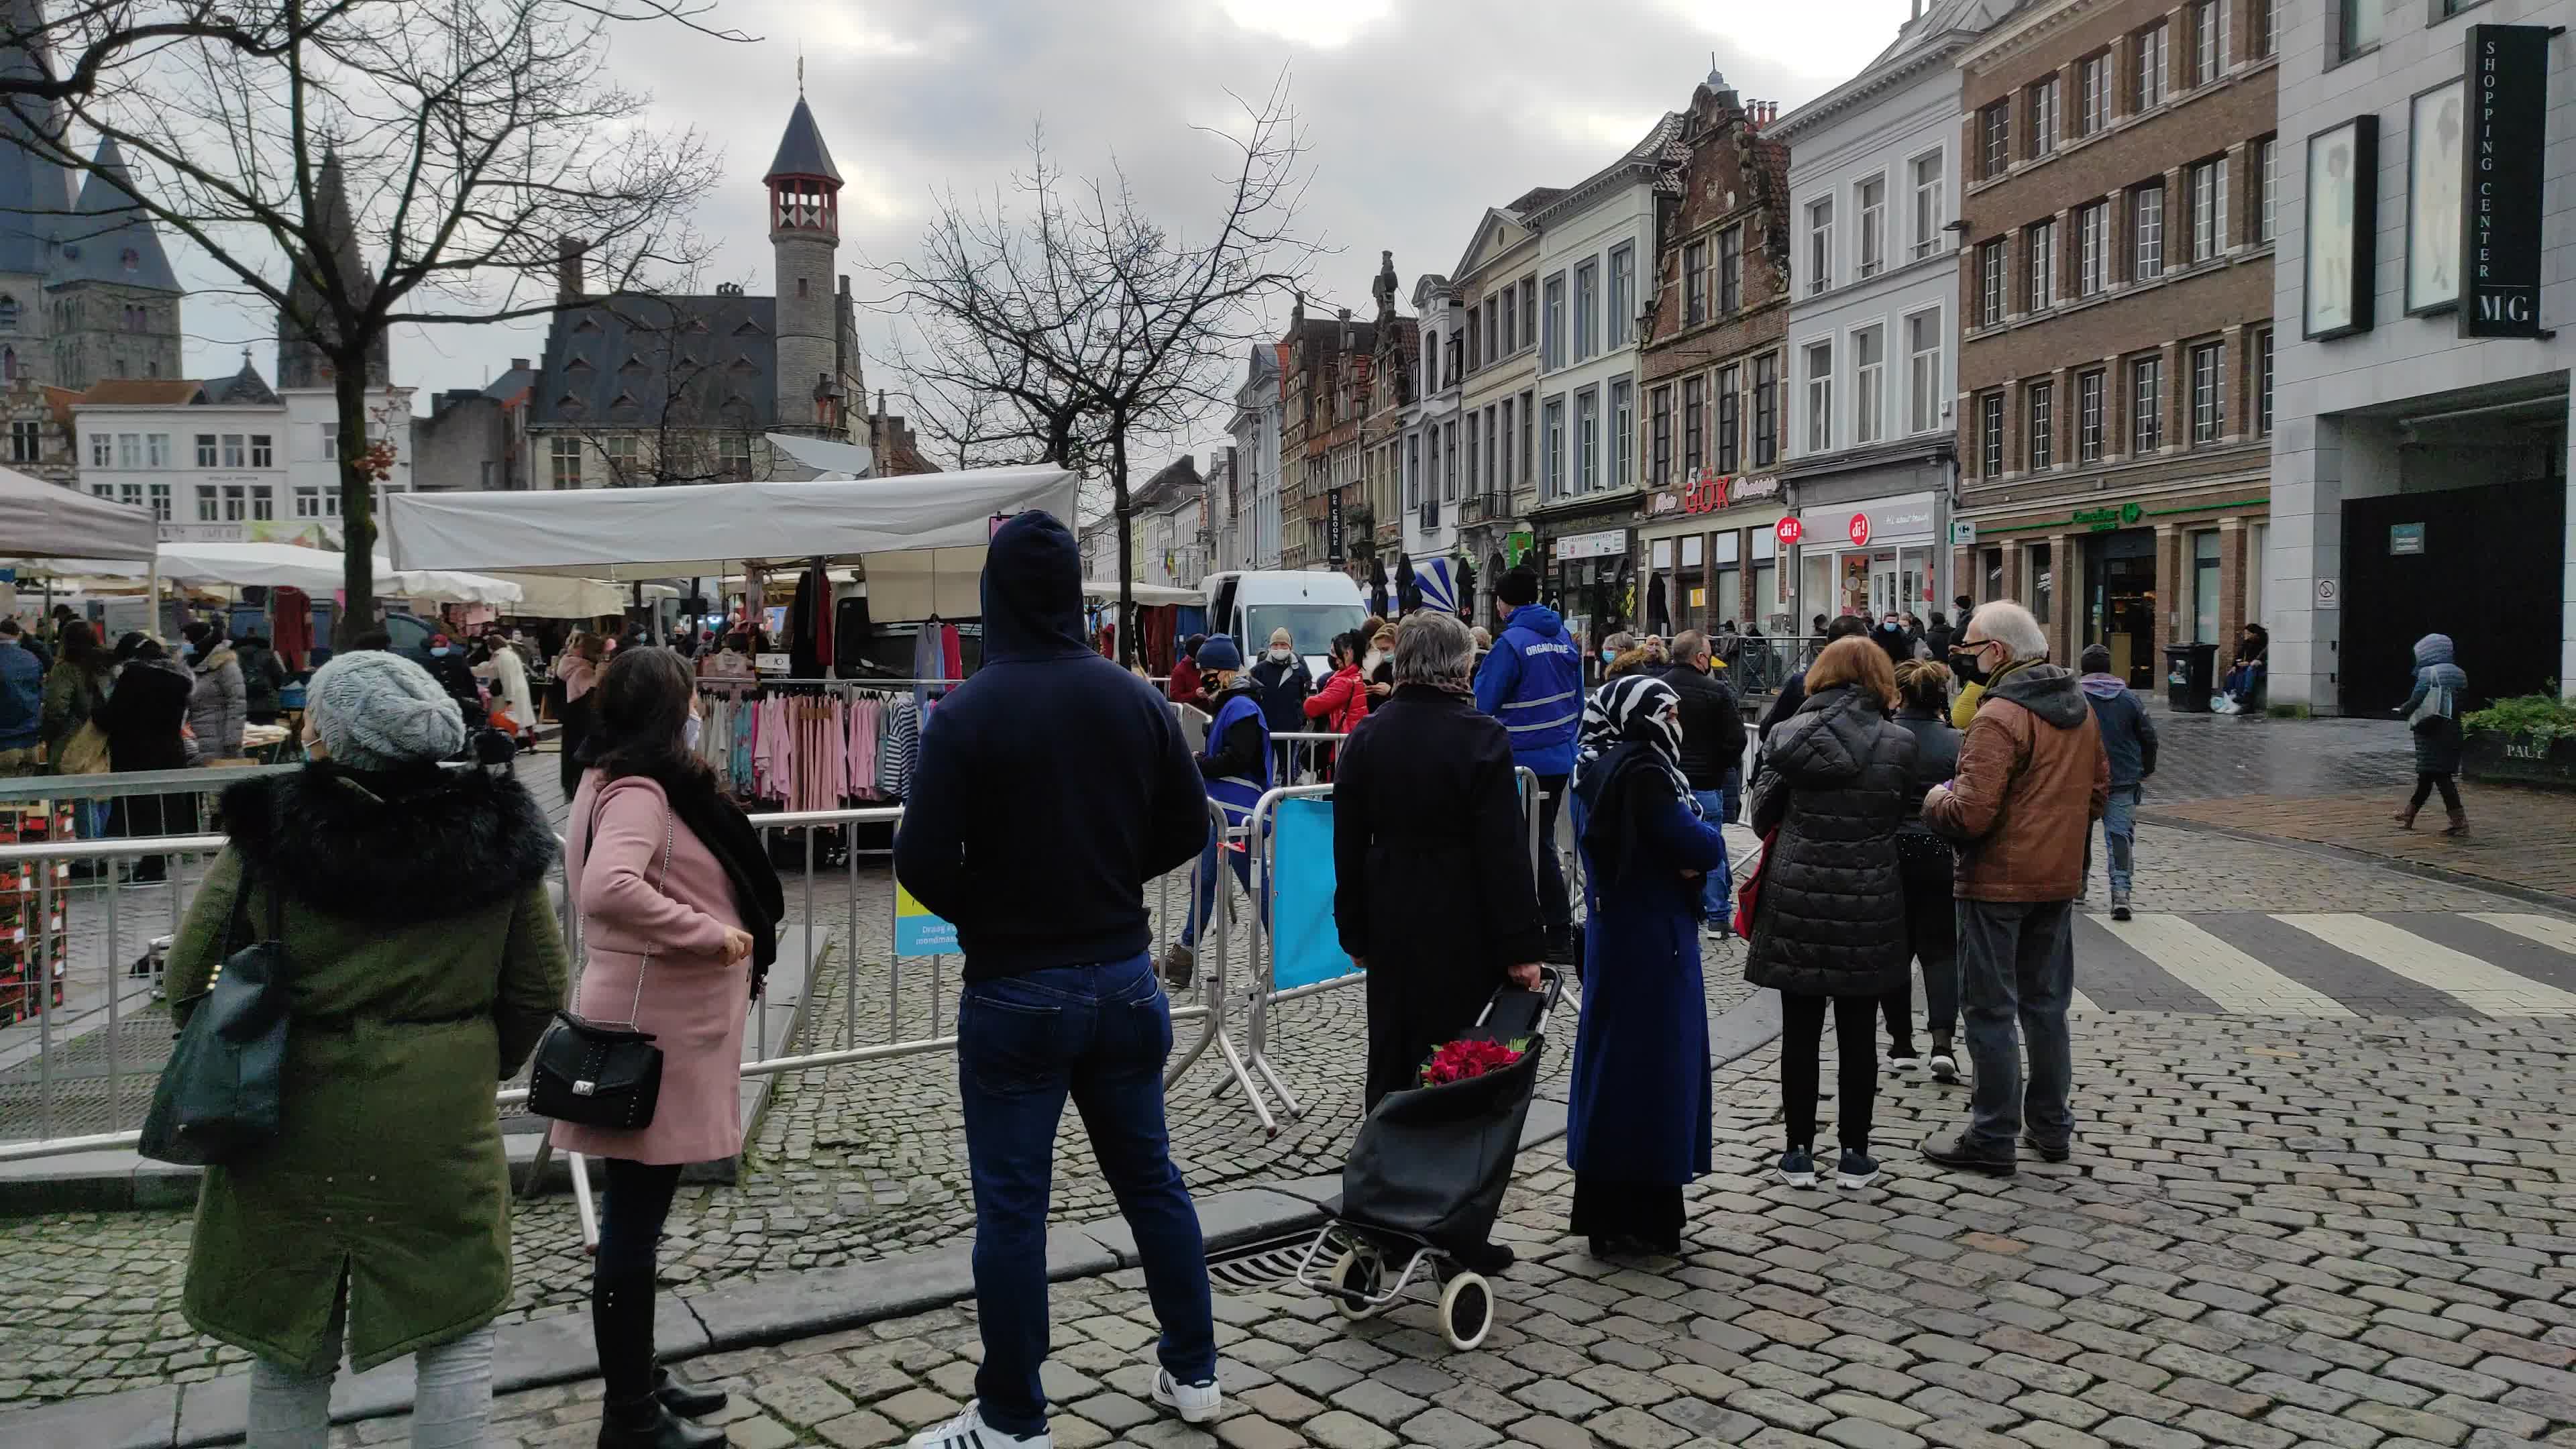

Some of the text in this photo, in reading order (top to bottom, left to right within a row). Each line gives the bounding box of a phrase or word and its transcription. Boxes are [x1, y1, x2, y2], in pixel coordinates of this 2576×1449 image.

[2479, 41, 2496, 277] SHOPPING CENTER
[1332, 494, 1338, 504] DE
[1780, 523, 1798, 537] di!
[1852, 520, 1866, 537] di!
